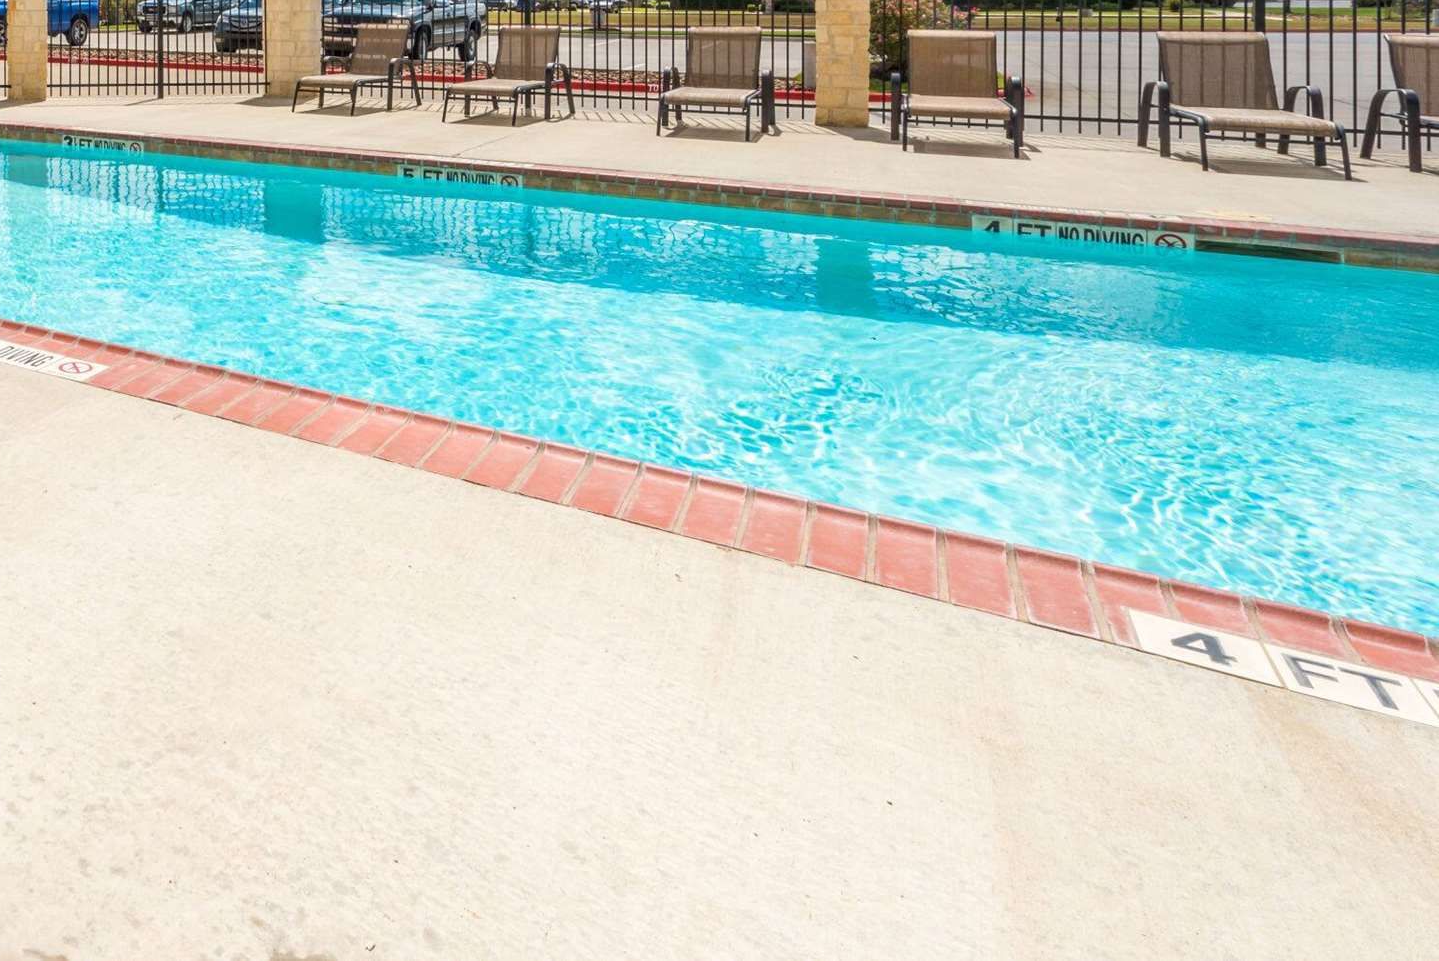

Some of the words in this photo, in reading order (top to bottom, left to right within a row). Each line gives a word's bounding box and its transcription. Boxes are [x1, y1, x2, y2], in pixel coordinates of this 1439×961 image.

[446, 171, 459, 182] NO
[461, 172, 496, 185] DIVING
[1058, 226, 1079, 240] NO
[1083, 228, 1144, 246] DIVING
[1170, 631, 1238, 667] 4
[1280, 652, 1402, 711] FT
